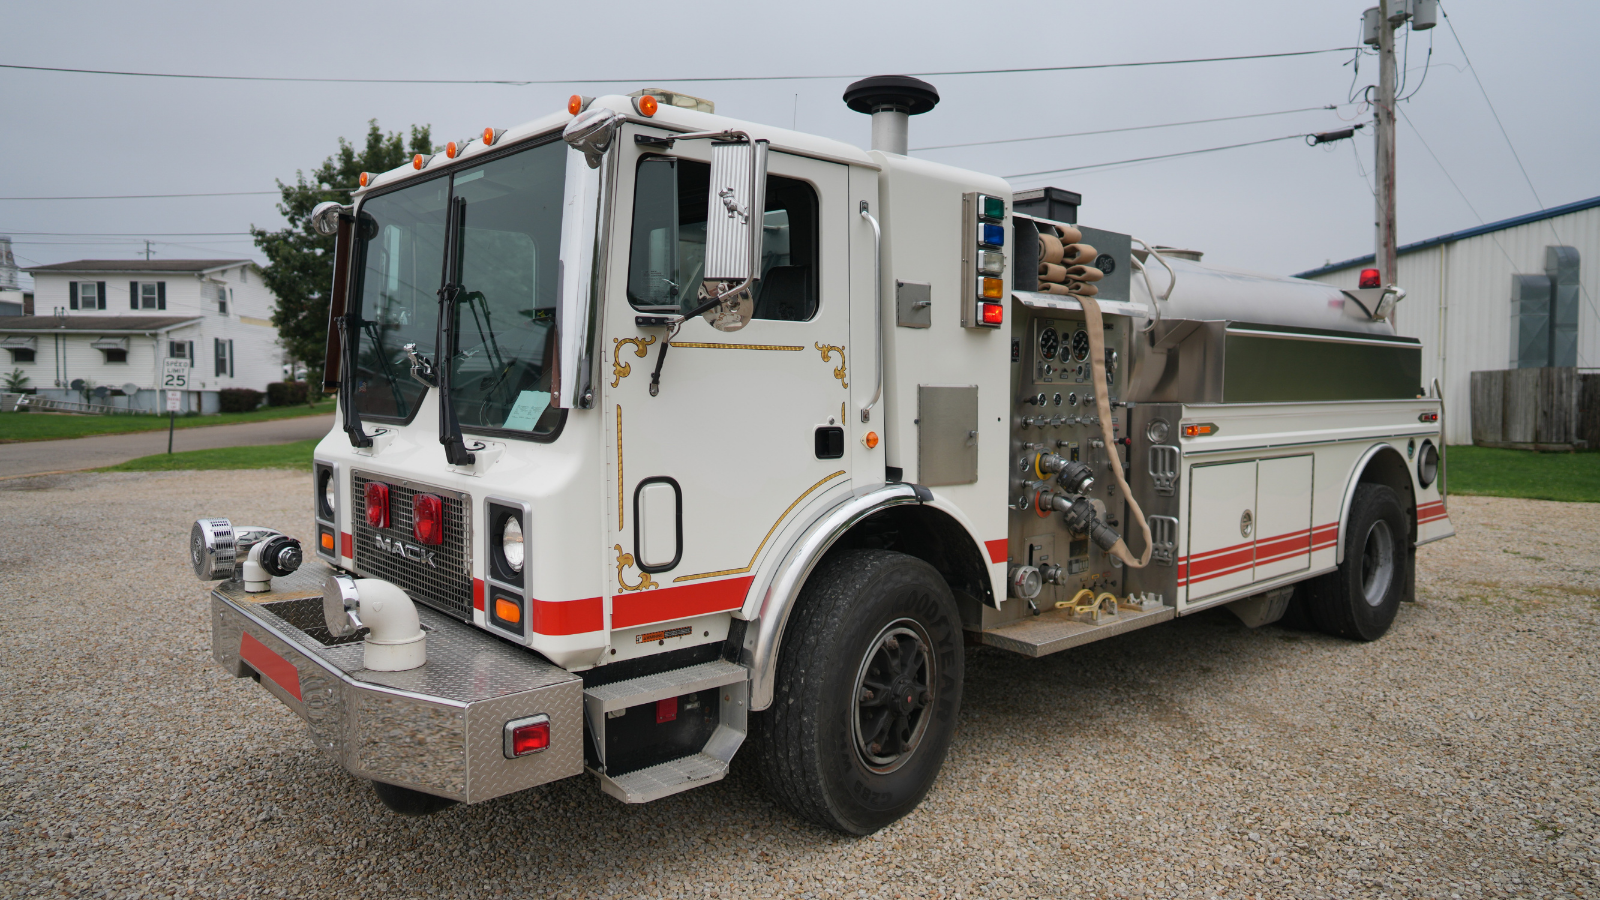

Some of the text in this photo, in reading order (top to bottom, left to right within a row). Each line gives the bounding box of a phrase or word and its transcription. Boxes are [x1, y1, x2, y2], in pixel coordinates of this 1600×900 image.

[165, 374, 186, 386] 25
[376, 534, 436, 568] MACK
[892, 590, 955, 722] GOODYEAR
